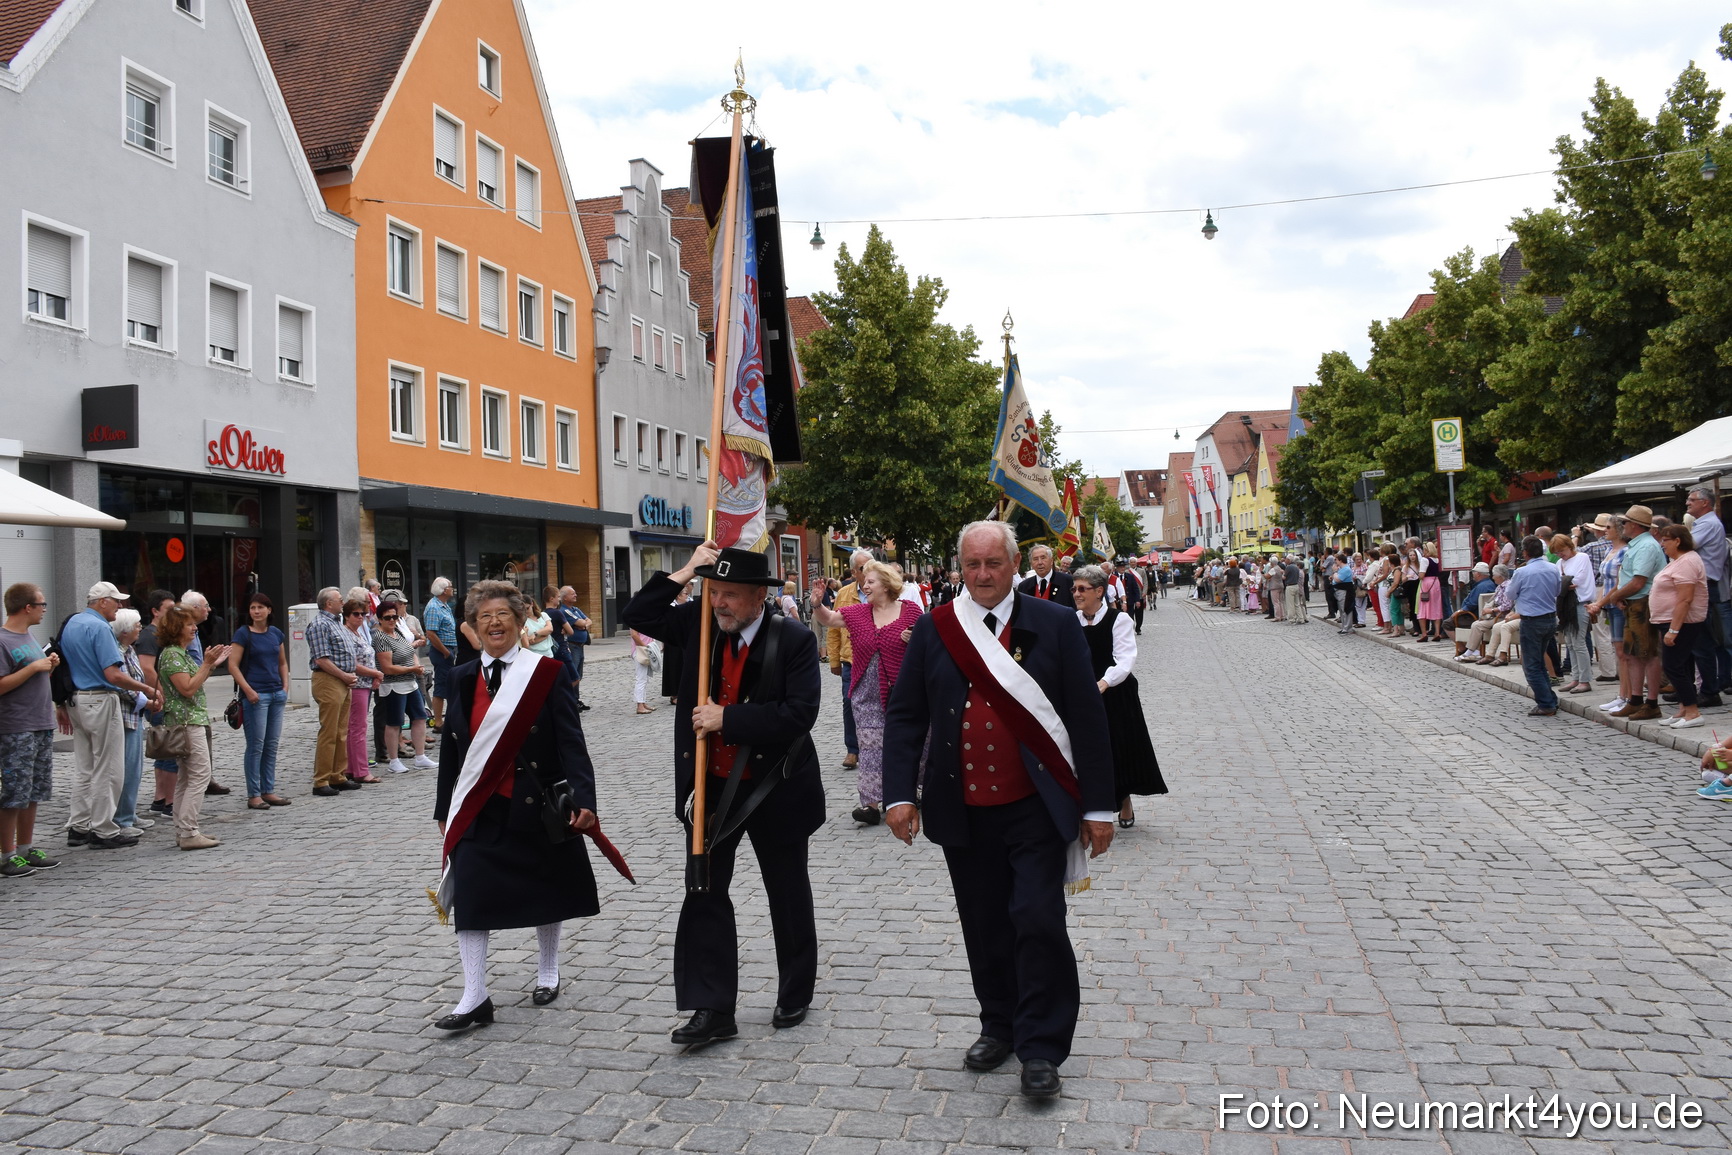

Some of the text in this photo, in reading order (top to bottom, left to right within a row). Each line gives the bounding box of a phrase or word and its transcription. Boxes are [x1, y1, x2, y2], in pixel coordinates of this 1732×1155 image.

[88, 424, 127, 443] s.Oliver
[208, 424, 287, 474] s.Oliver
[17, 530, 24, 538] 29
